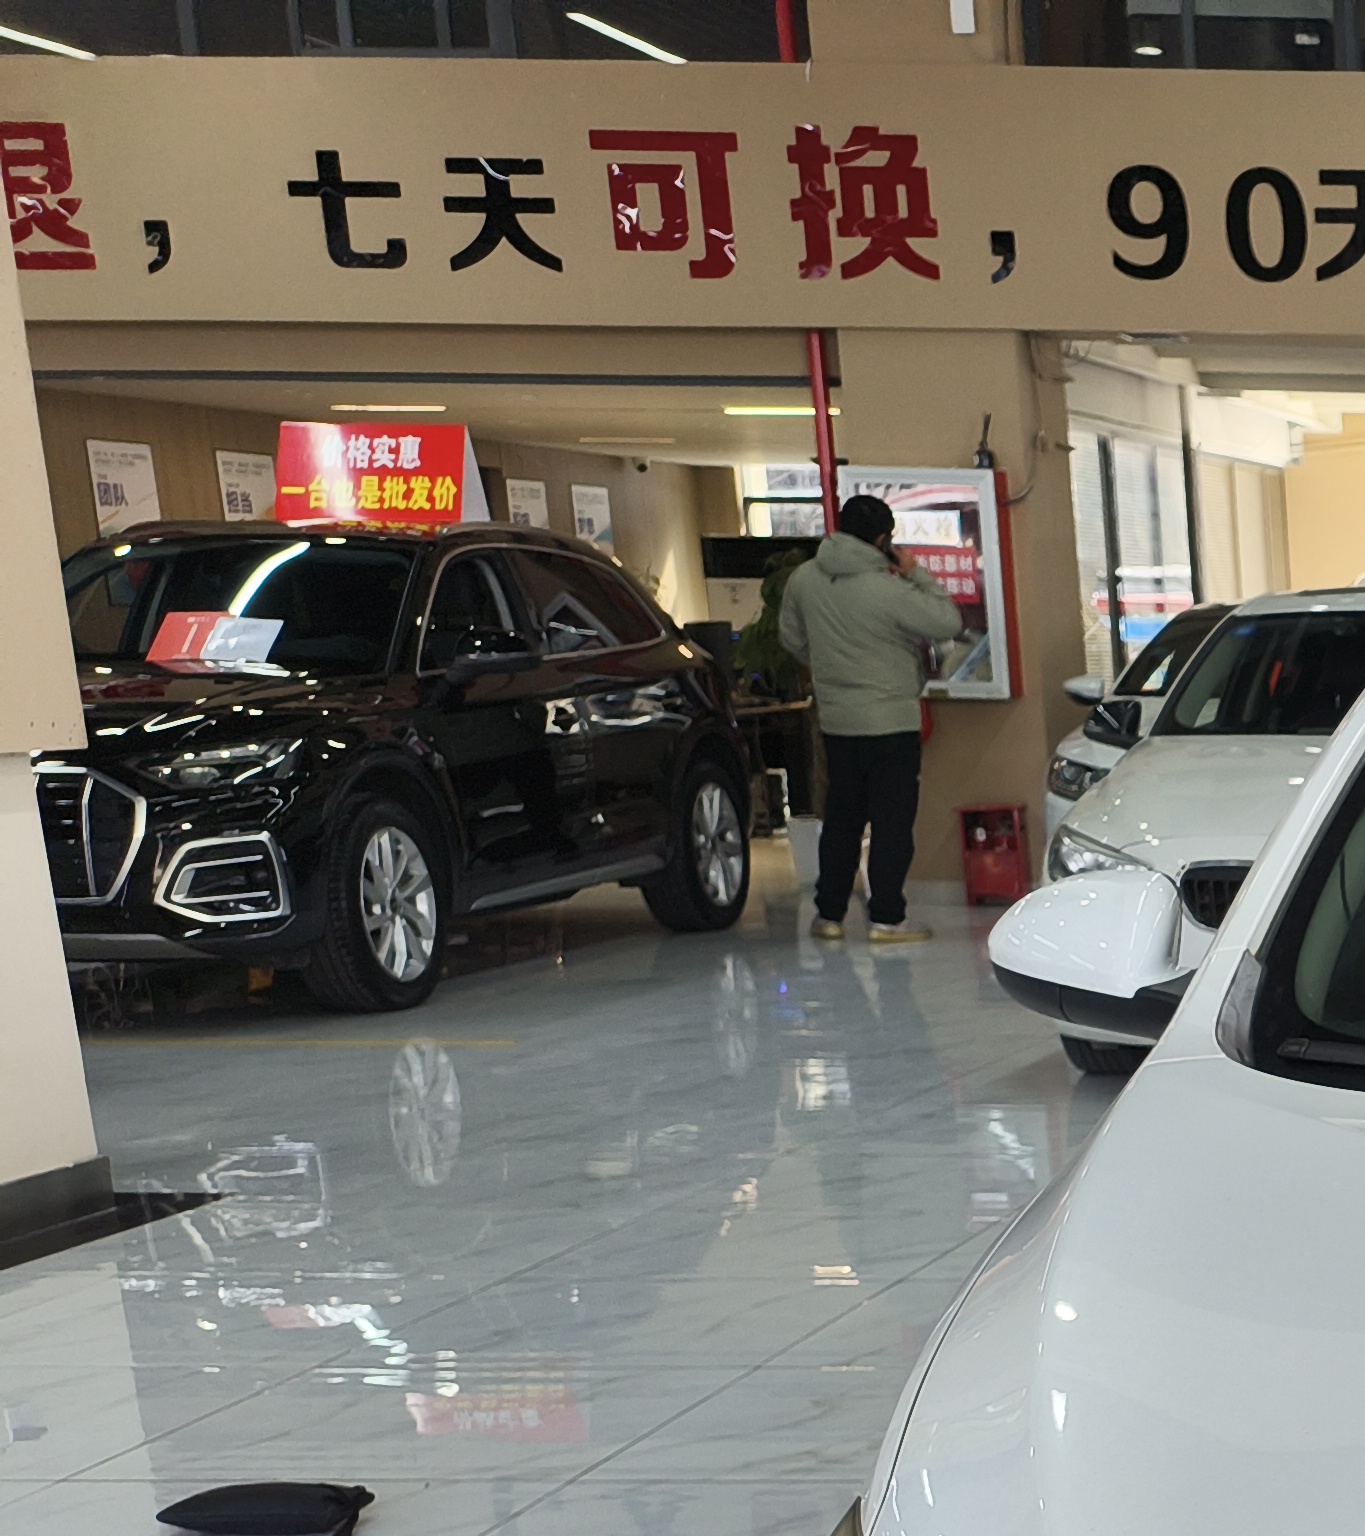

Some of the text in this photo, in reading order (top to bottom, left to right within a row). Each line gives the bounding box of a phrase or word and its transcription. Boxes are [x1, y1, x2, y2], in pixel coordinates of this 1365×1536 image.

[322, 433, 422, 470] 价格实惠
[280, 474, 458, 511] 一台也是批发价
